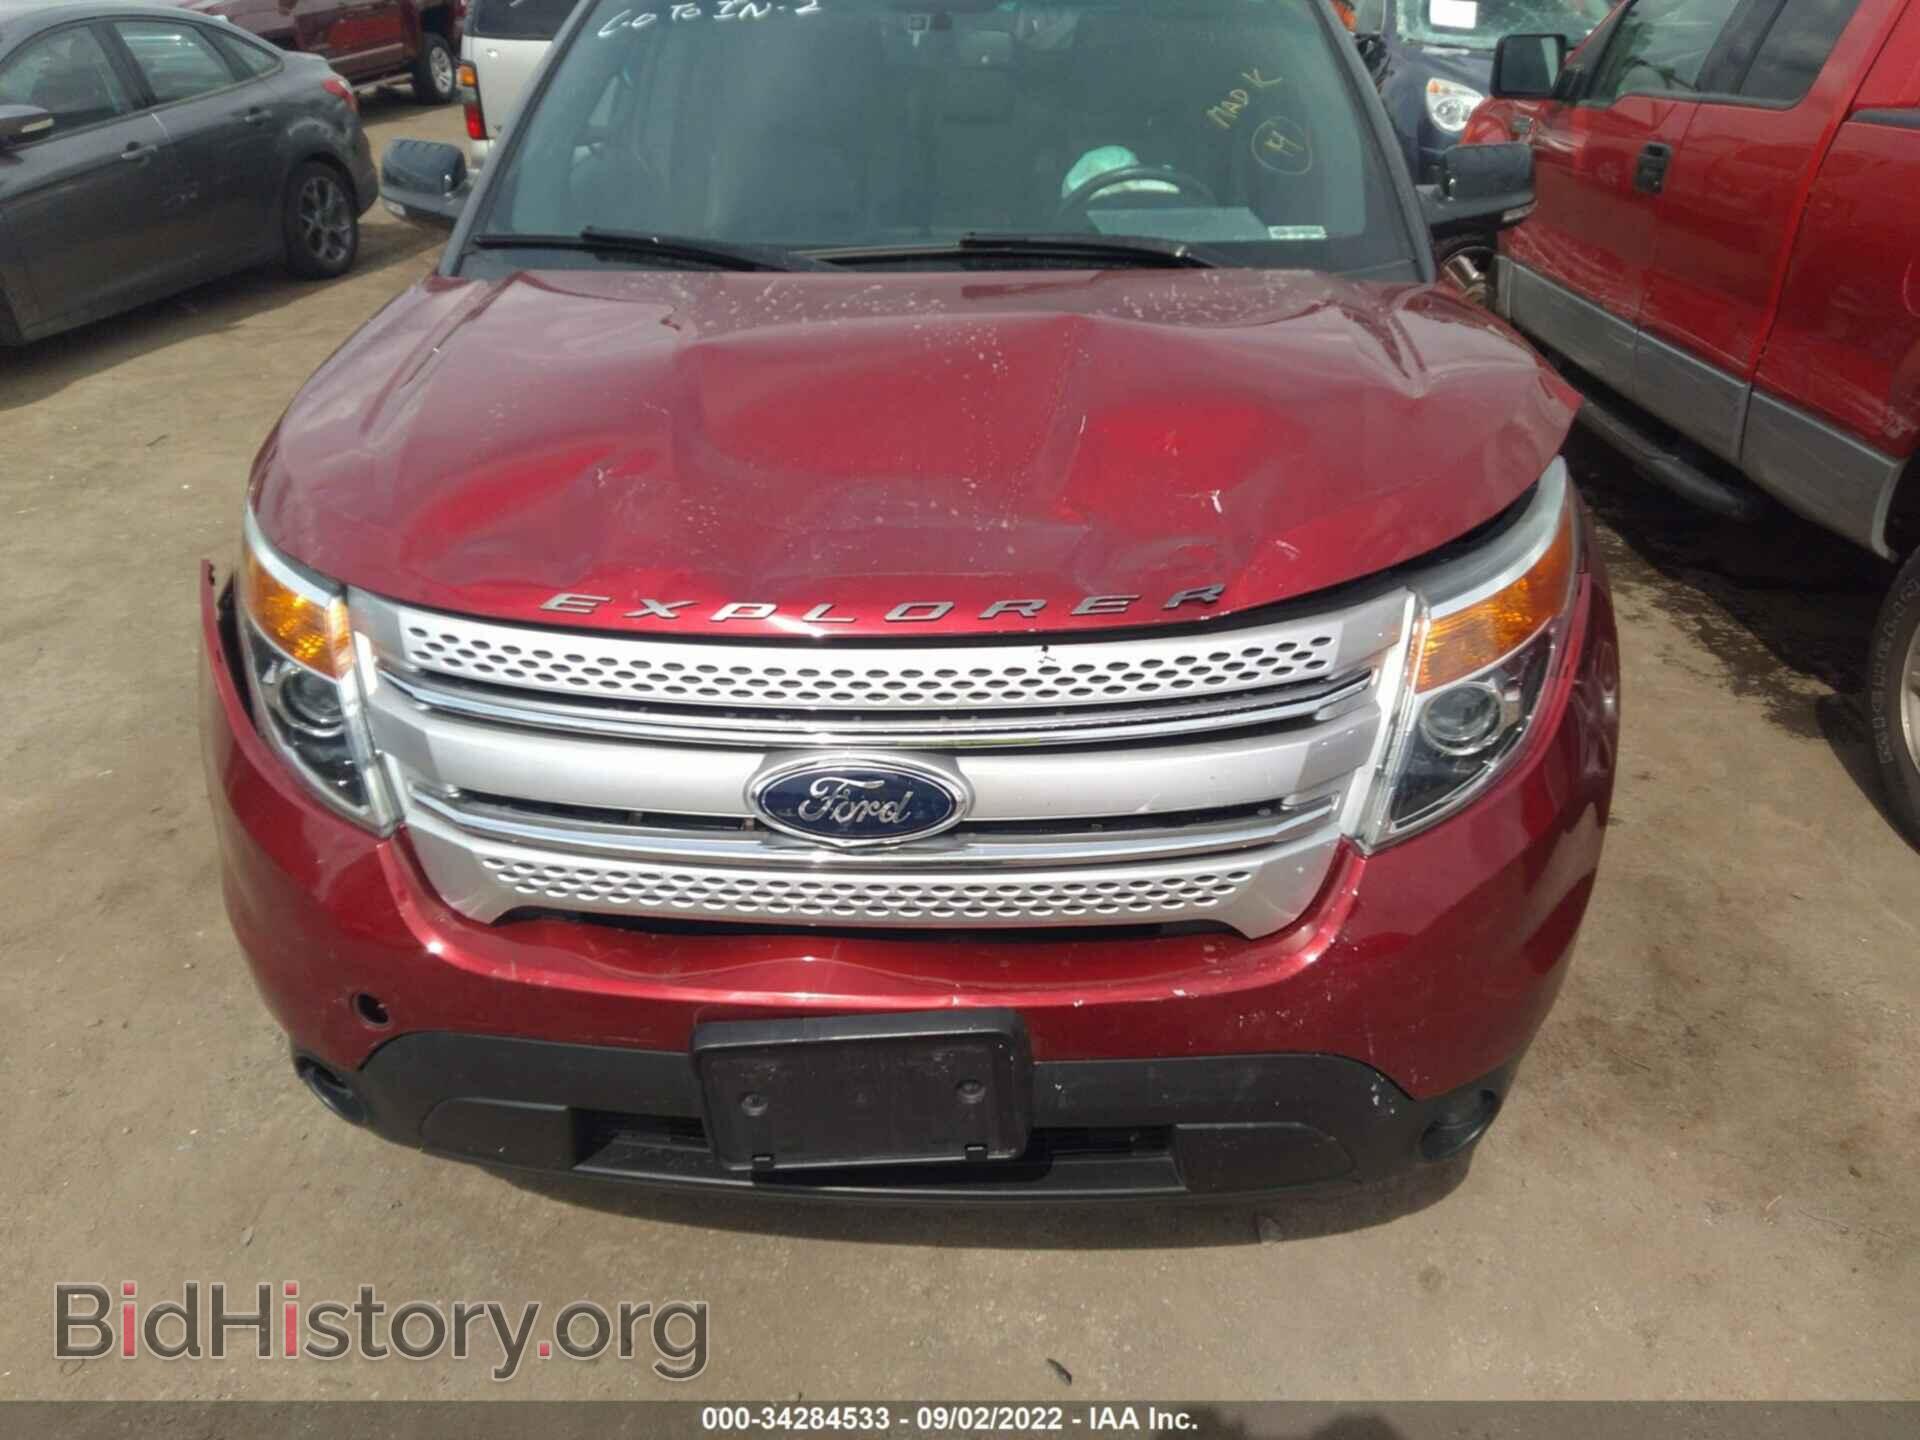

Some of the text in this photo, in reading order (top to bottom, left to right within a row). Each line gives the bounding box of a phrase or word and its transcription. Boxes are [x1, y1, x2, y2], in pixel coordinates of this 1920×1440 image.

[670, 3, 702, 21] TO
[539, 582, 1226, 624] EXPLORER
[798, 776, 914, 824] Ford
